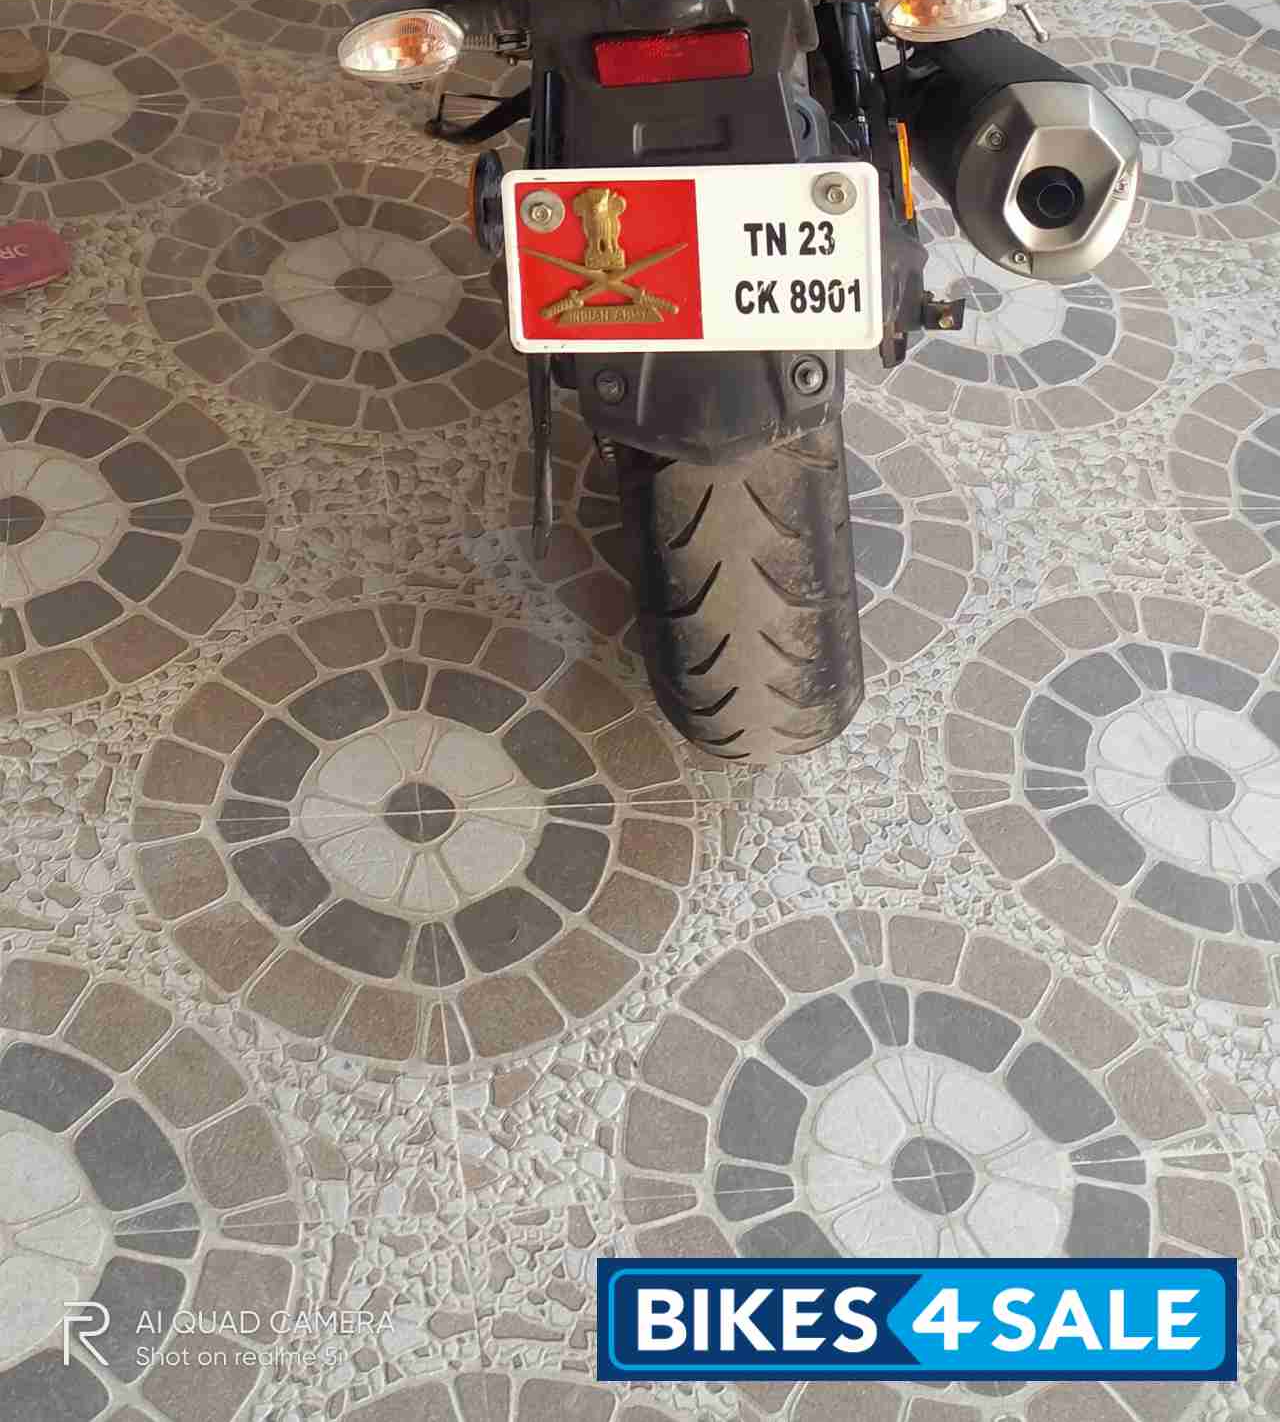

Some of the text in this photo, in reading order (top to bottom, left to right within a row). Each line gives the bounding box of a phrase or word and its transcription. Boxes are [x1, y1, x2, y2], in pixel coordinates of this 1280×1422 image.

[744, 221, 835, 257] TN 23
[735, 279, 862, 315] CK 8901
